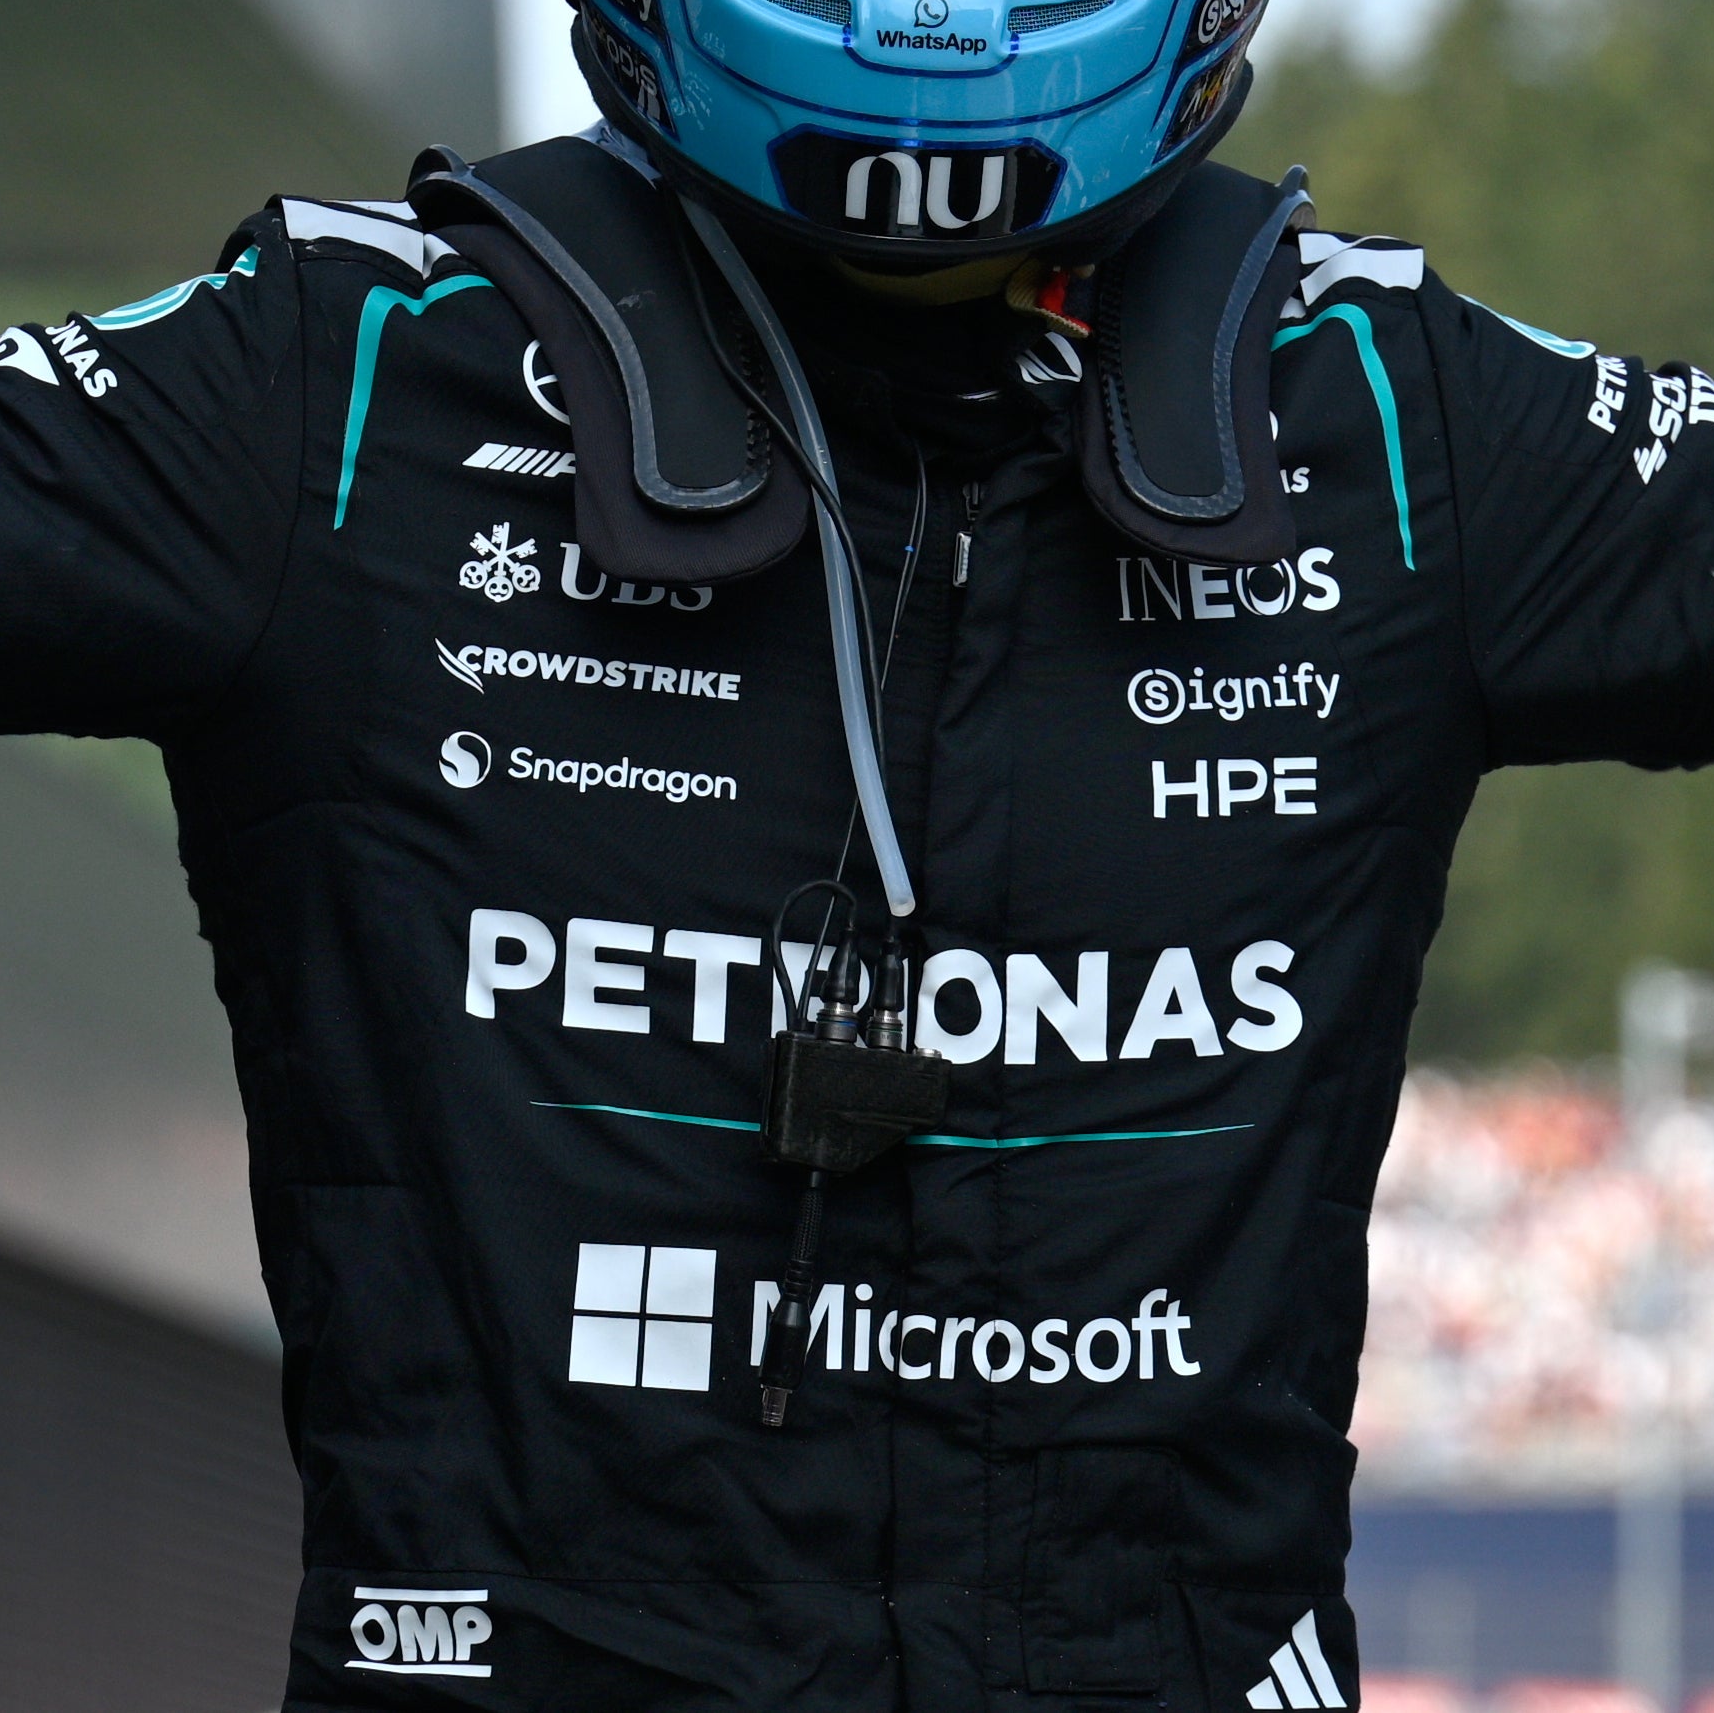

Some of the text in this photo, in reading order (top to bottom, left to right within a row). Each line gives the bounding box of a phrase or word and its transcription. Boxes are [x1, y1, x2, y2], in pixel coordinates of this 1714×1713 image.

[876, 29, 987, 56] WhatsApp
[1115, 547, 1342, 623] INEOS
[456, 644, 742, 702] CROWDSTRIKE
[507, 747, 738, 804] Snapdragon
[1151, 757, 1319, 819] HPE
[750, 1280, 1202, 1384] Microsoft
[349, 1602, 493, 1663] OMP
